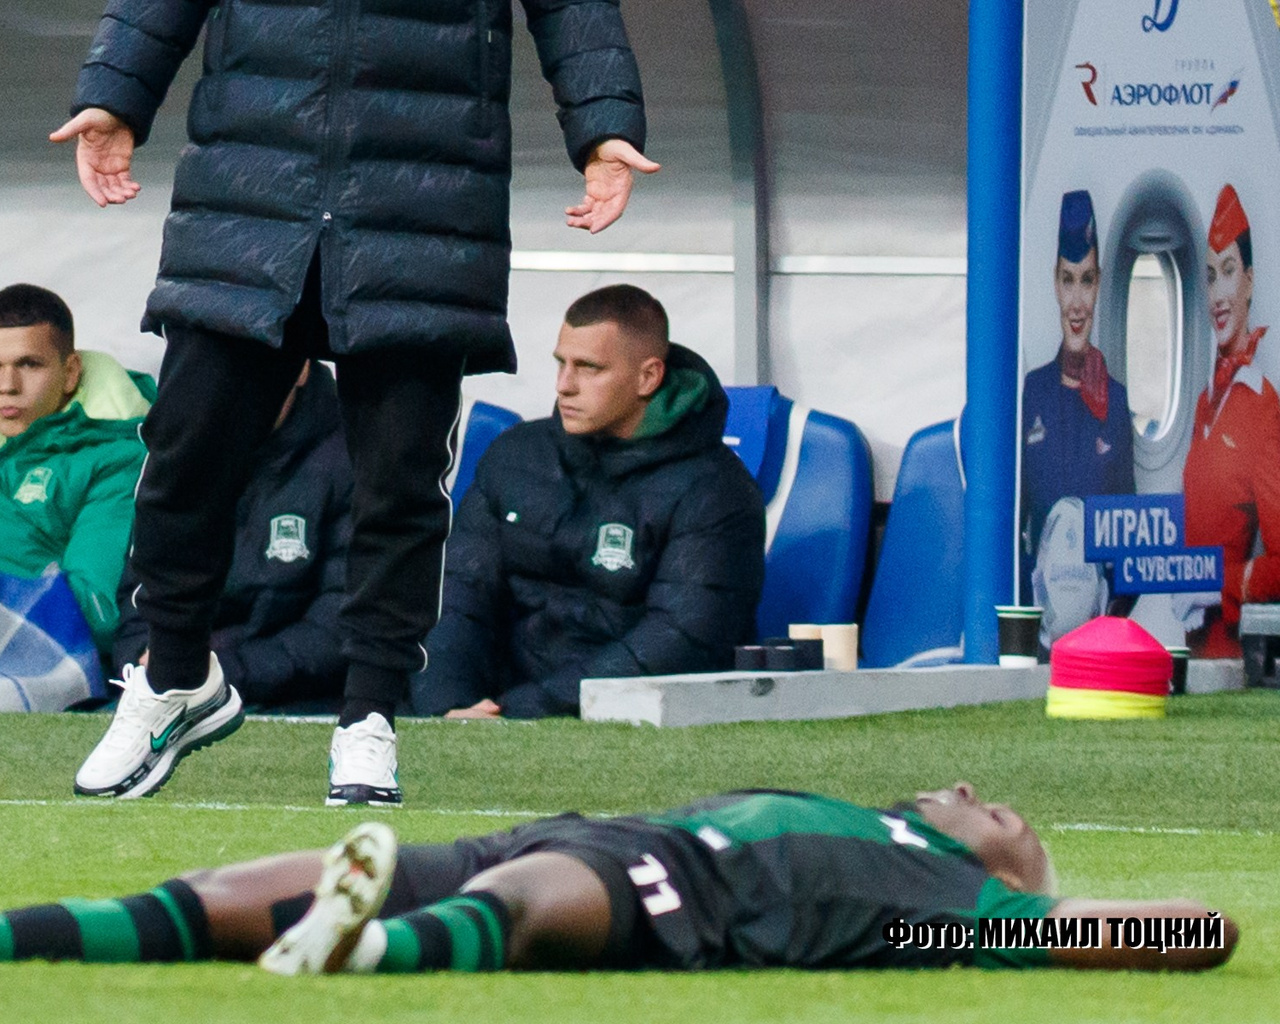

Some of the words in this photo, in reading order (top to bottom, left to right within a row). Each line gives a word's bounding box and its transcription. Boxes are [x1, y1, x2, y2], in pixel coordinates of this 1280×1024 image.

[1111, 83, 1213, 106] АЭРОФЛОТ
[1094, 507, 1177, 548] ИГРАТЬ
[1123, 557, 1134, 583] С
[1136, 555, 1216, 582] ЧУВСТВОМ
